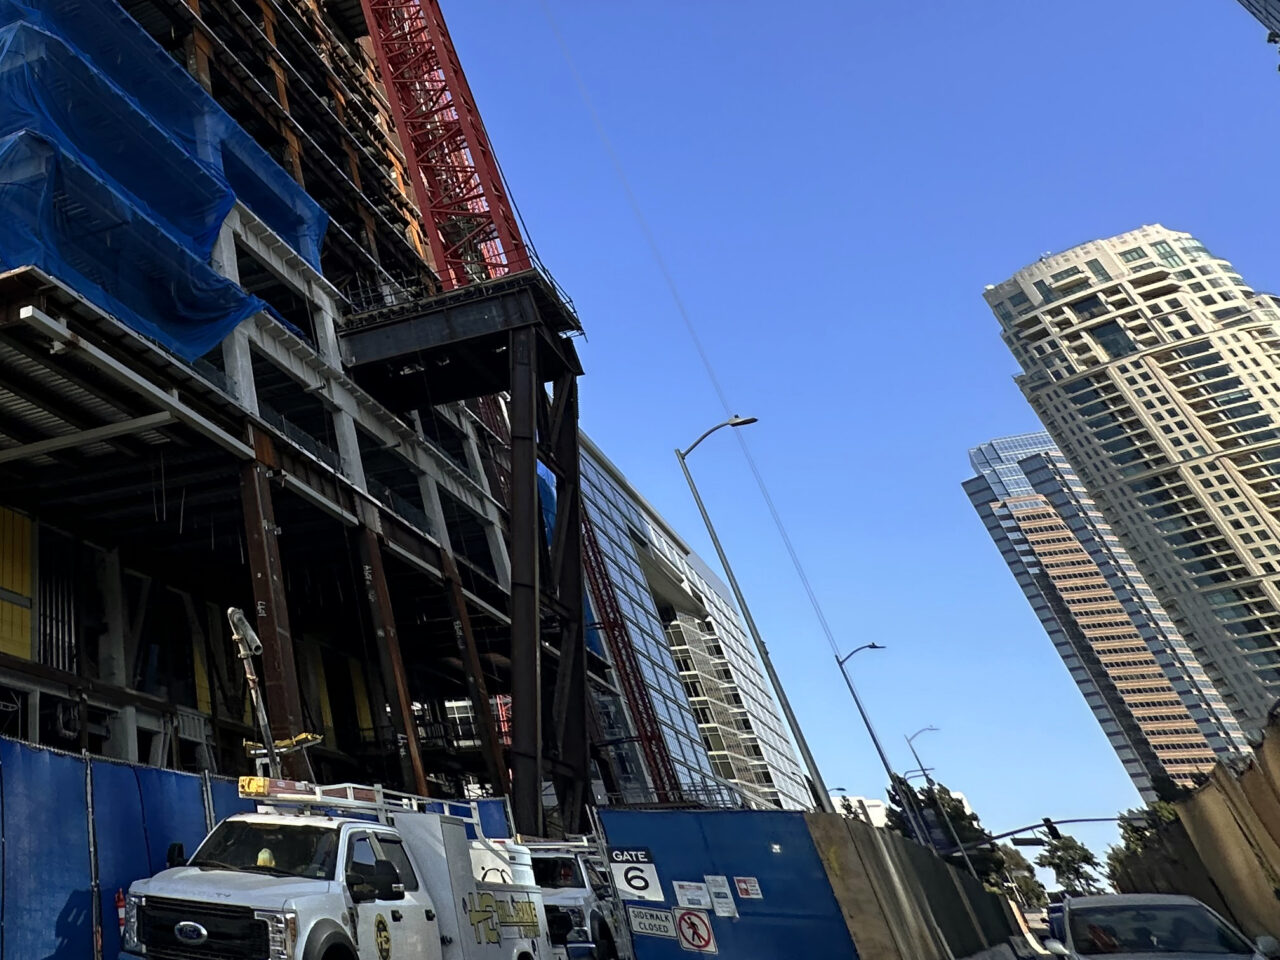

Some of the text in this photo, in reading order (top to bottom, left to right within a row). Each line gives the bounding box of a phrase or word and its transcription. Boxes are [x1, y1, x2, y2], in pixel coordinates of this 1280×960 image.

[612, 850, 648, 862] GATE
[623, 866, 650, 891] 6
[632, 910, 671, 923] SIDEWALK
[638, 921, 669, 934] CLOSED
